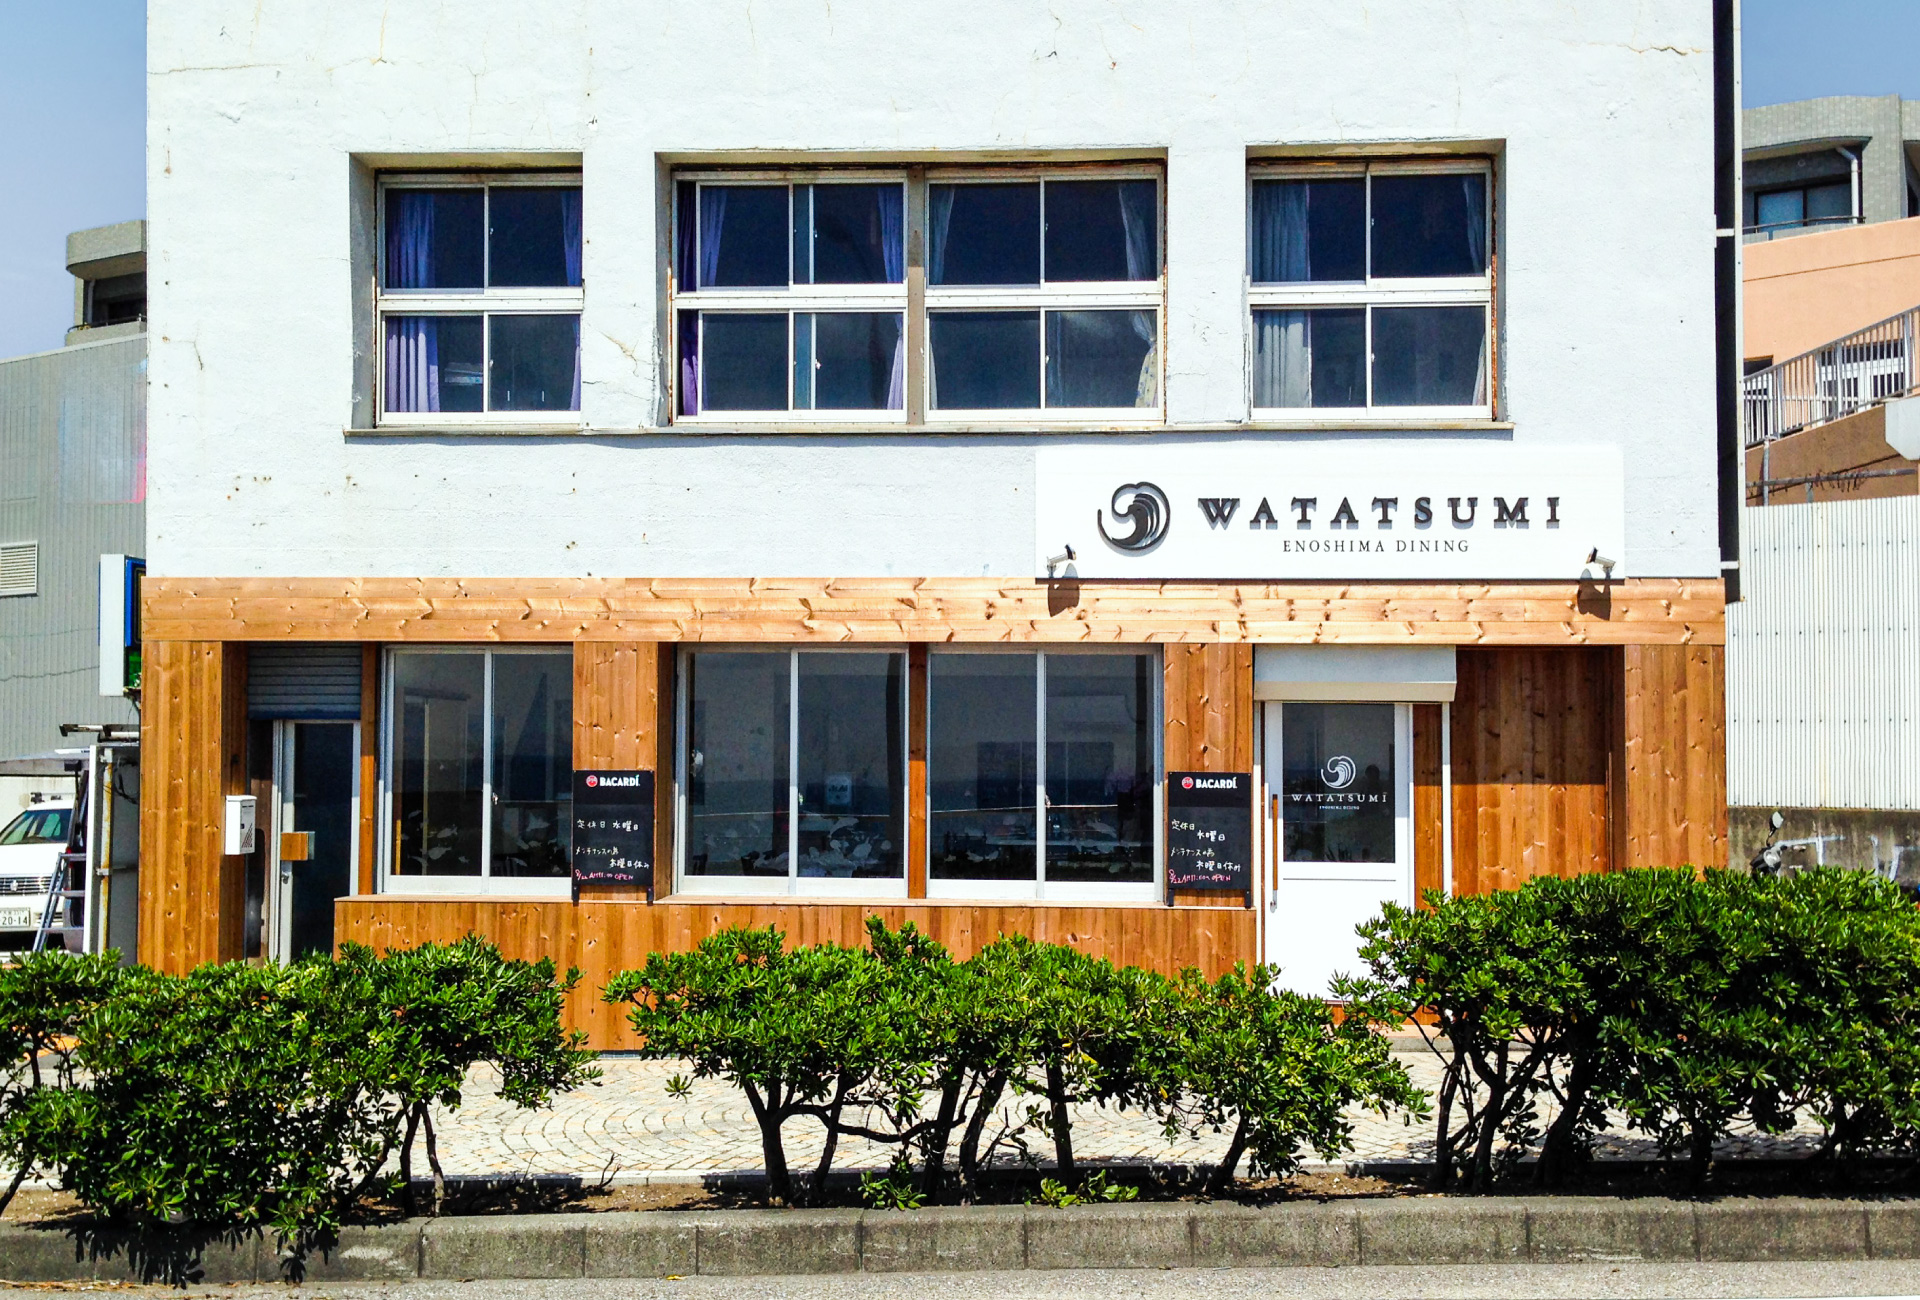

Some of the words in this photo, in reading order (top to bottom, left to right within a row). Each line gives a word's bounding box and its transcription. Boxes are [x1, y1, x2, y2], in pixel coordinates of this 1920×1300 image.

[1198, 496, 1560, 526] WATATSUMI
[1284, 540, 1386, 552] ENOSHIMA
[1396, 540, 1469, 552] DINING
[599, 774, 641, 787] BACARDÍ
[1195, 776, 1238, 789] BACARDÍ
[1291, 793, 1387, 803] WATATSUMI
[576, 818, 606, 830] 定休日
[612, 819, 639, 832] 水曜日
[1171, 818, 1195, 831] 定休日
[1196, 829, 1226, 842] 水曜日
[614, 872, 634, 881] OPEN
[1211, 873, 1232, 883] OPEN
